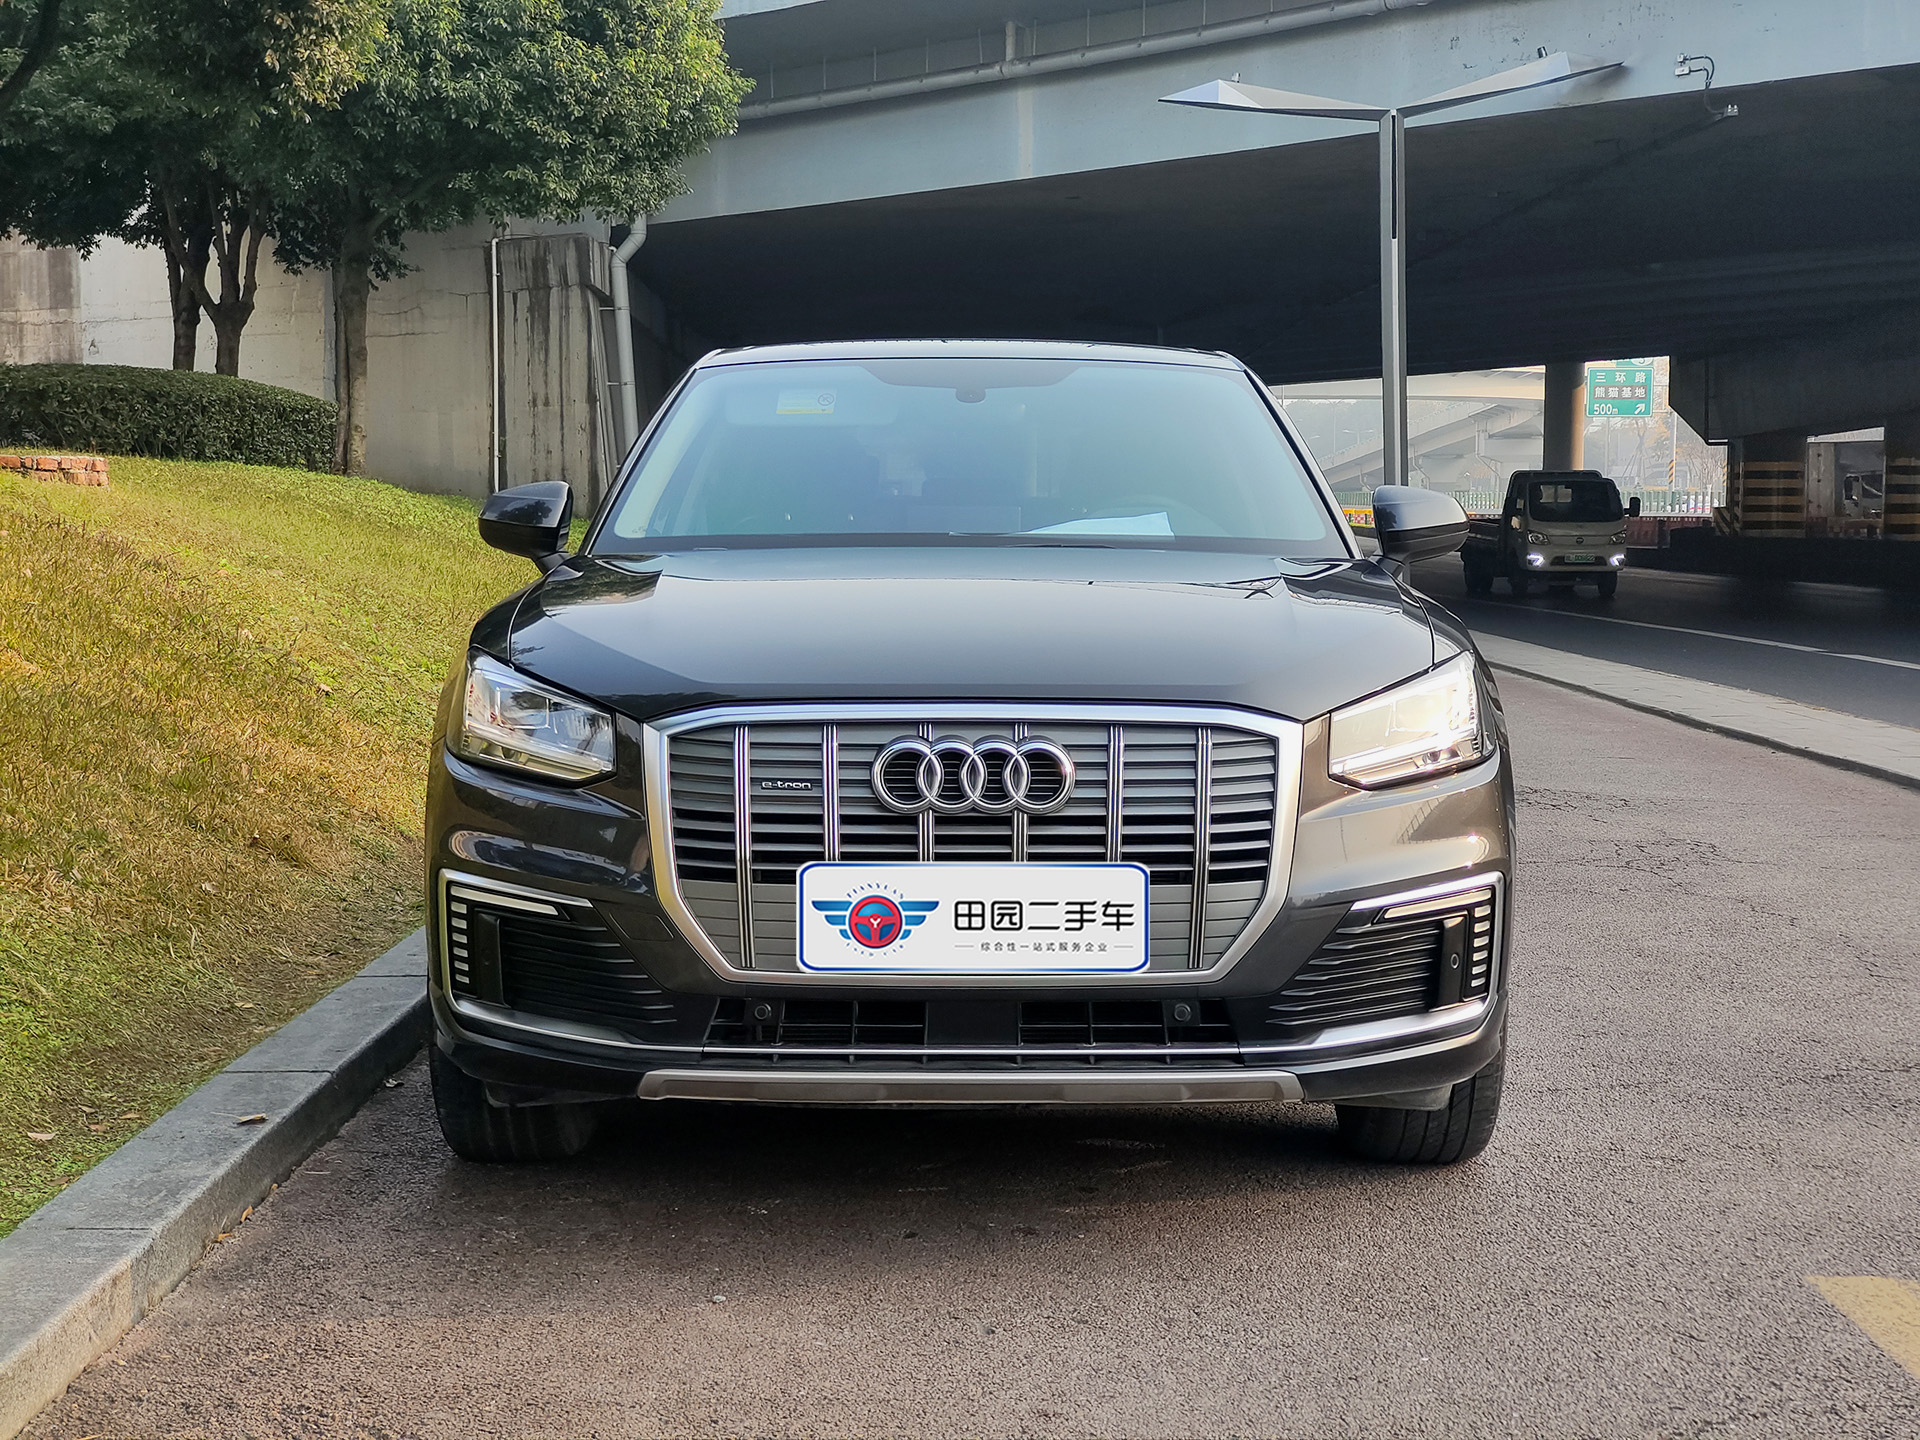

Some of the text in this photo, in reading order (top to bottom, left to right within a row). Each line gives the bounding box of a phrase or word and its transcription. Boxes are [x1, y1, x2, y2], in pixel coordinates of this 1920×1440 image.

[1595, 371, 1647, 383] 三环路
[1594, 386, 1646, 398] 熊猫基地
[761, 780, 812, 789] e-tron
